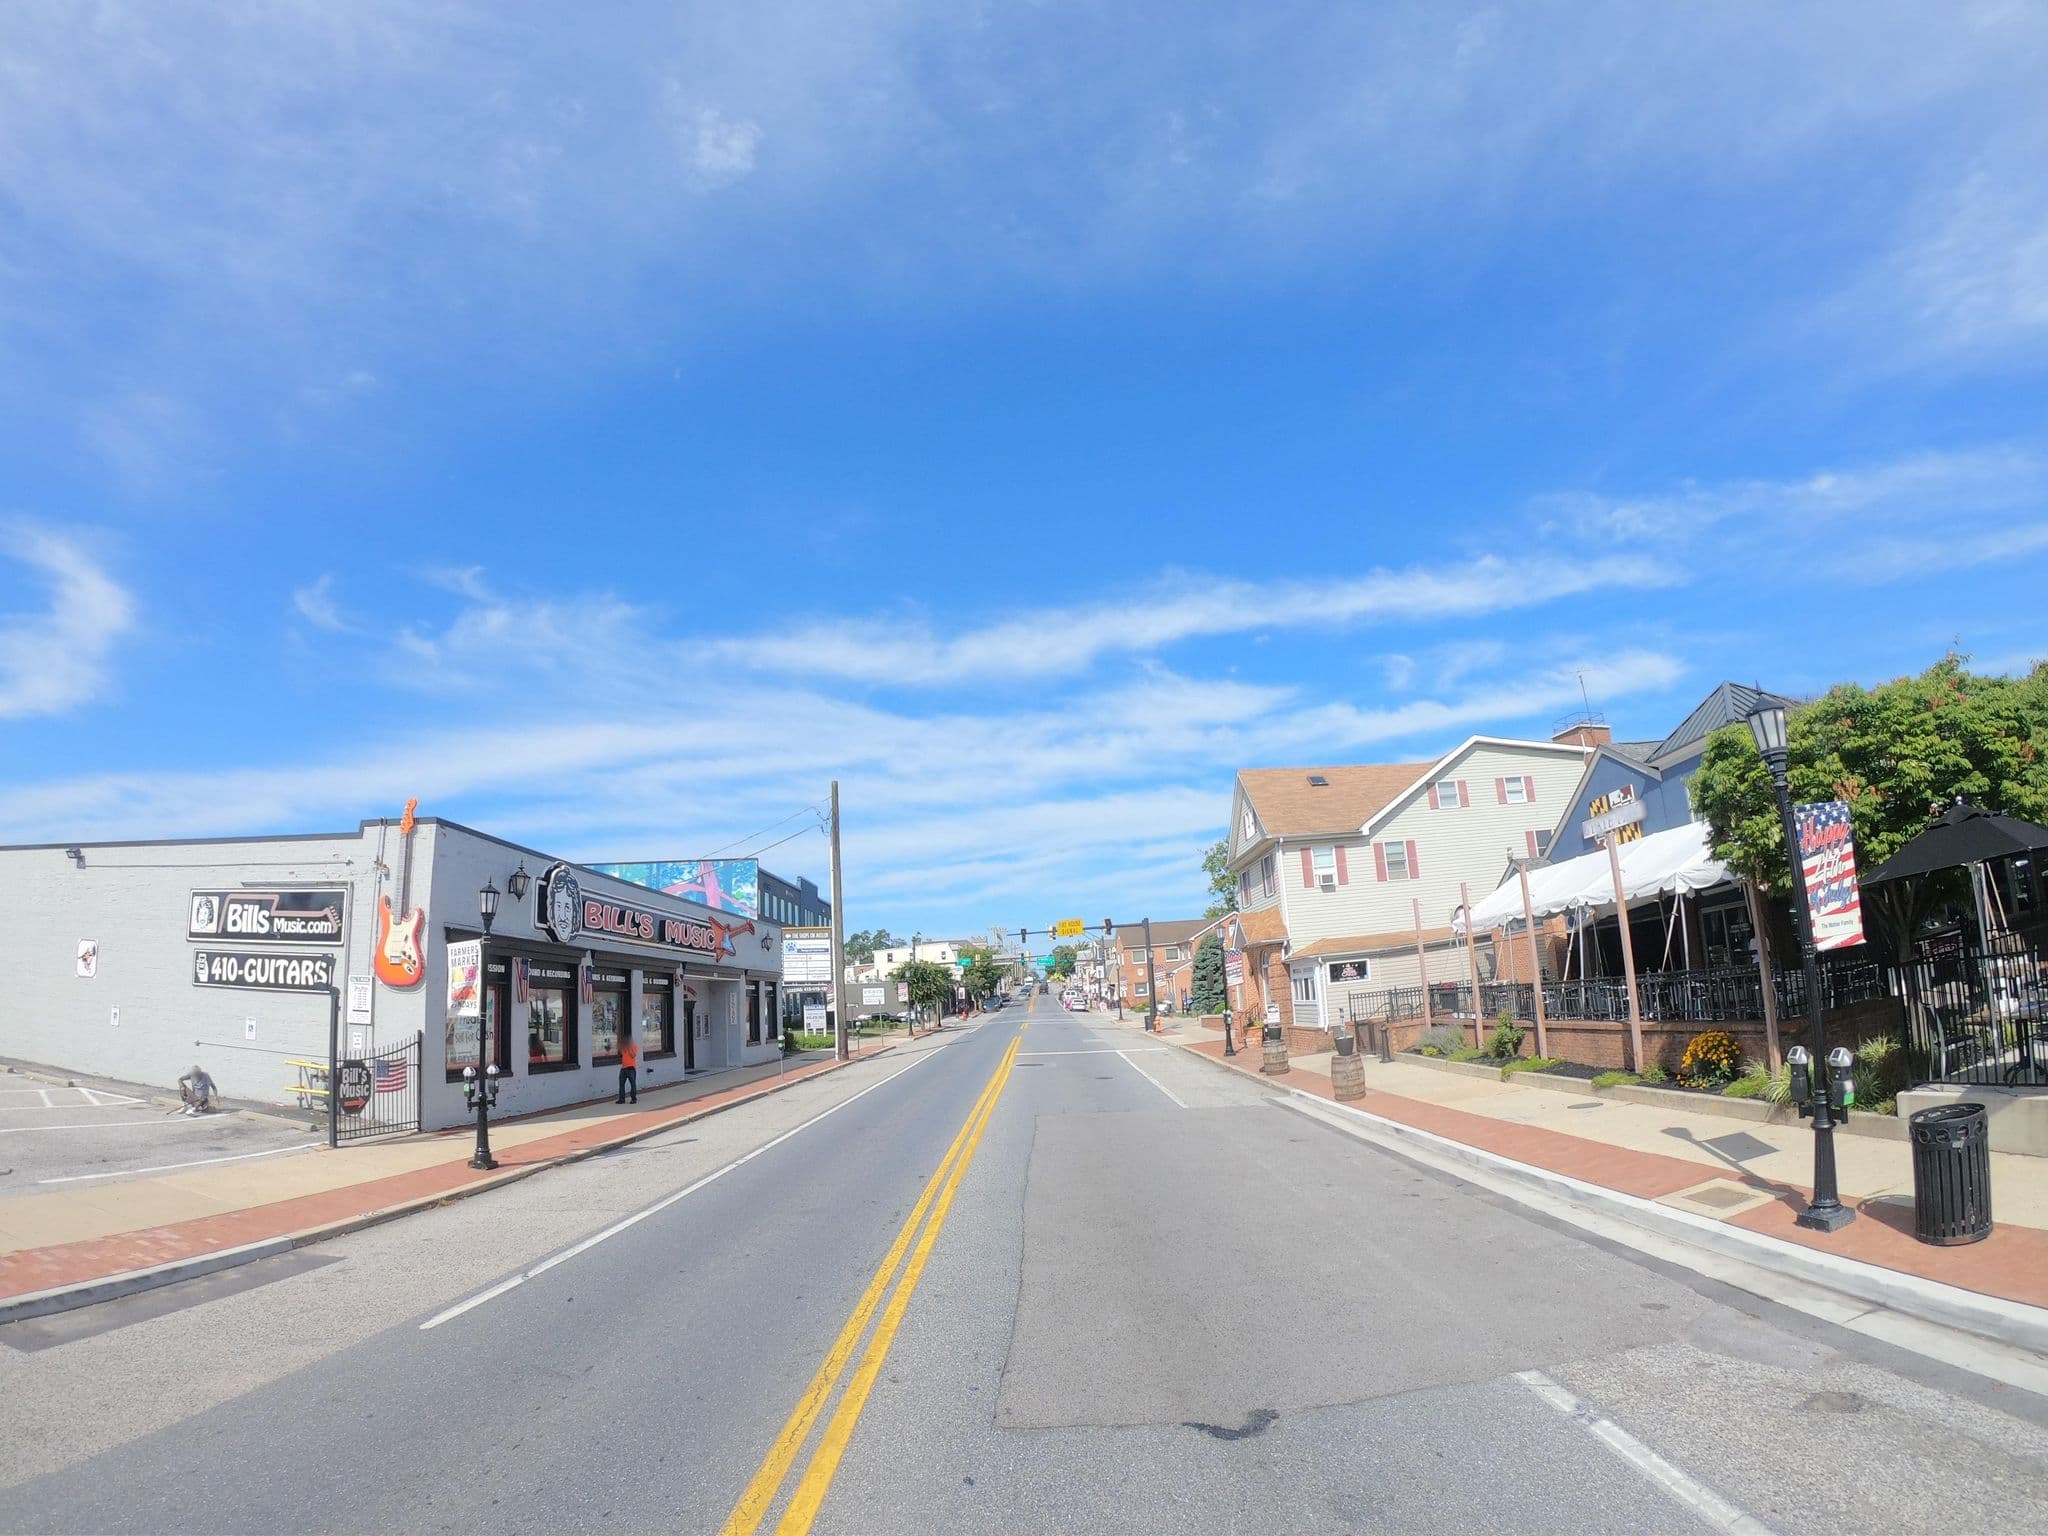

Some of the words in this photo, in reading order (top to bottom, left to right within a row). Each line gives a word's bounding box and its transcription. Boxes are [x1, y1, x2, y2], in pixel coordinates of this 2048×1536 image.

[1801, 816, 1850, 856] Happy
[1815, 848, 1845, 884] 4th
[226, 903, 271, 934] Bills
[273, 917, 332, 934] Music.com
[584, 900, 654, 939] BILL'S
[665, 919, 717, 950] MUSIC
[450, 945, 479, 957] FARMERS
[451, 954, 480, 968] MARKET
[211, 956, 328, 986] 410-GUITARS
[528, 967, 541, 977] OUND
[342, 1067, 368, 1083] Bill's
[340, 1083, 369, 1099] Music
